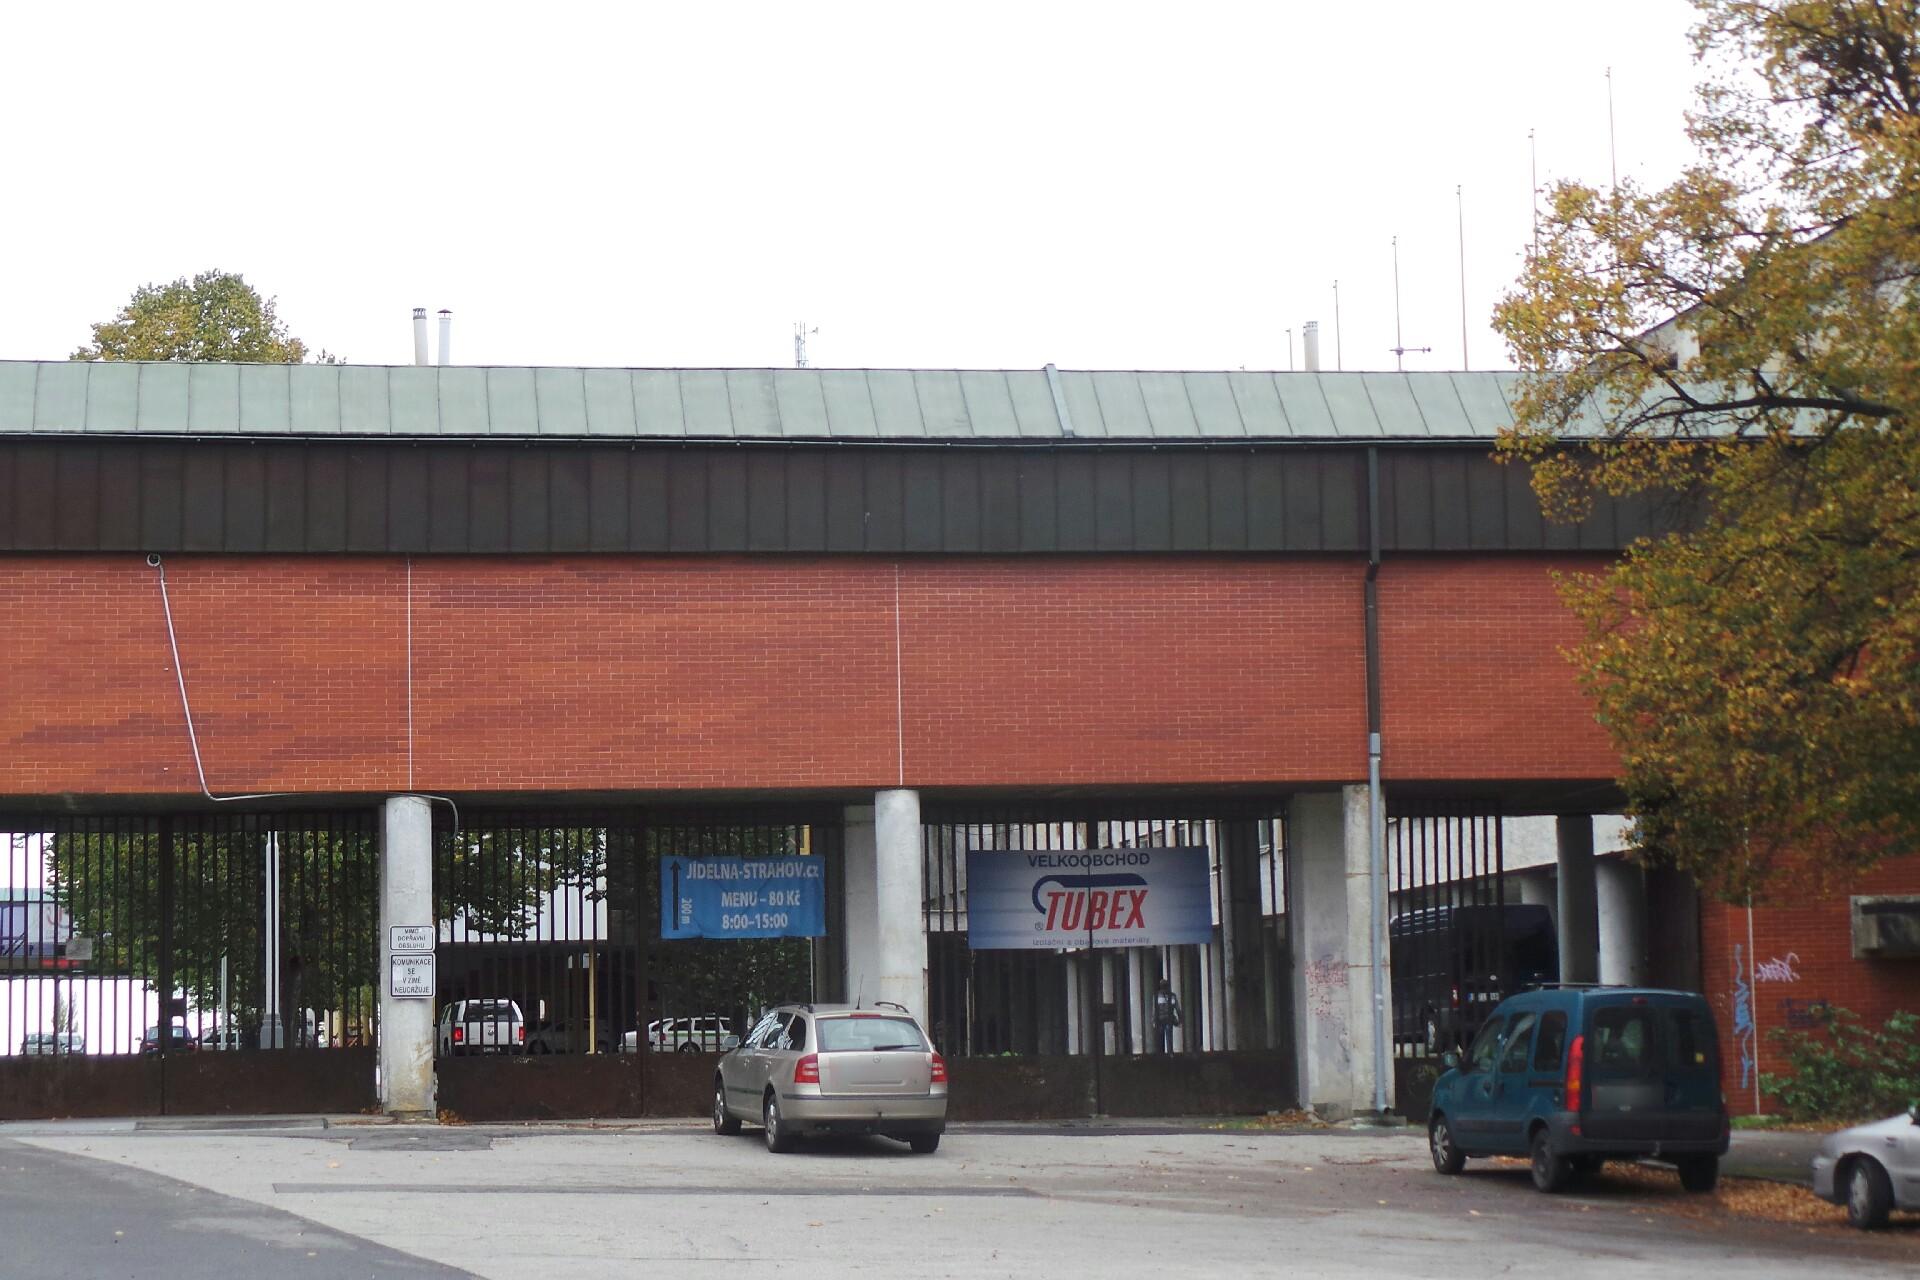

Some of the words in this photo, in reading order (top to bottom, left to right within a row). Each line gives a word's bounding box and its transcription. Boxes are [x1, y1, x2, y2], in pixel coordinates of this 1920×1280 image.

[1028, 853, 1150, 867] VELKOOBCHOD
[721, 891, 758, 908] MENU
[768, 890, 784, 906] 80
[786, 889, 800, 906] Kč
[1046, 890, 1148, 931] TUBEX
[392, 958, 432, 966] KOMUNIKACE
